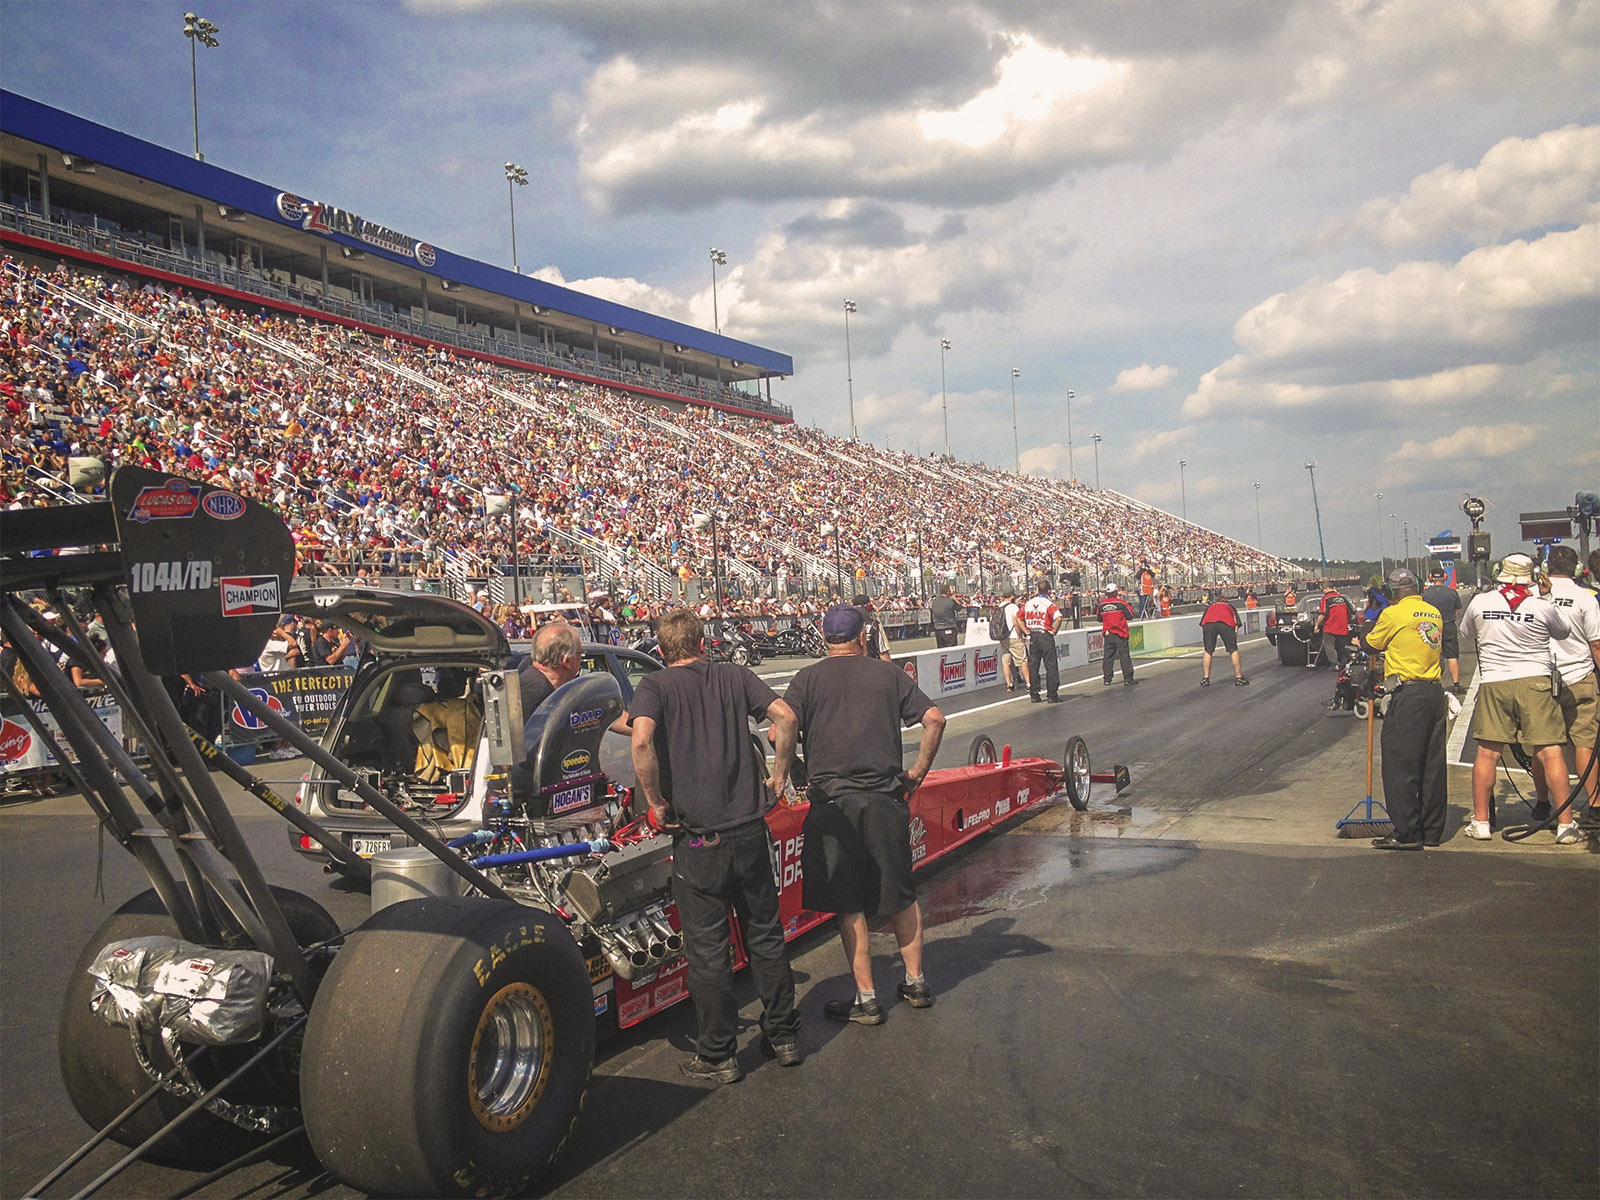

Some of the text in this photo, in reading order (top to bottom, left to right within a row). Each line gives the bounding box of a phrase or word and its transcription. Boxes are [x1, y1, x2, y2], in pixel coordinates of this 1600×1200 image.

[140, 494, 193, 506] LUCAS OIL
[209, 497, 240, 514] NHRA
[131, 560, 213, 593] 104A/FD
[225, 588, 276, 603] CHAMPION
[1482, 610, 1535, 622] ESPN 2
[940, 653, 967, 692] SUMMIT
[975, 648, 998, 686] SUMMIT
[271, 679, 293, 694] THE
[295, 676, 342, 691] PERFECT
[304, 693, 337, 704] OUTDOOR
[316, 702, 337, 711] TOOLS
[554, 786, 590, 809] HOGAN'S
